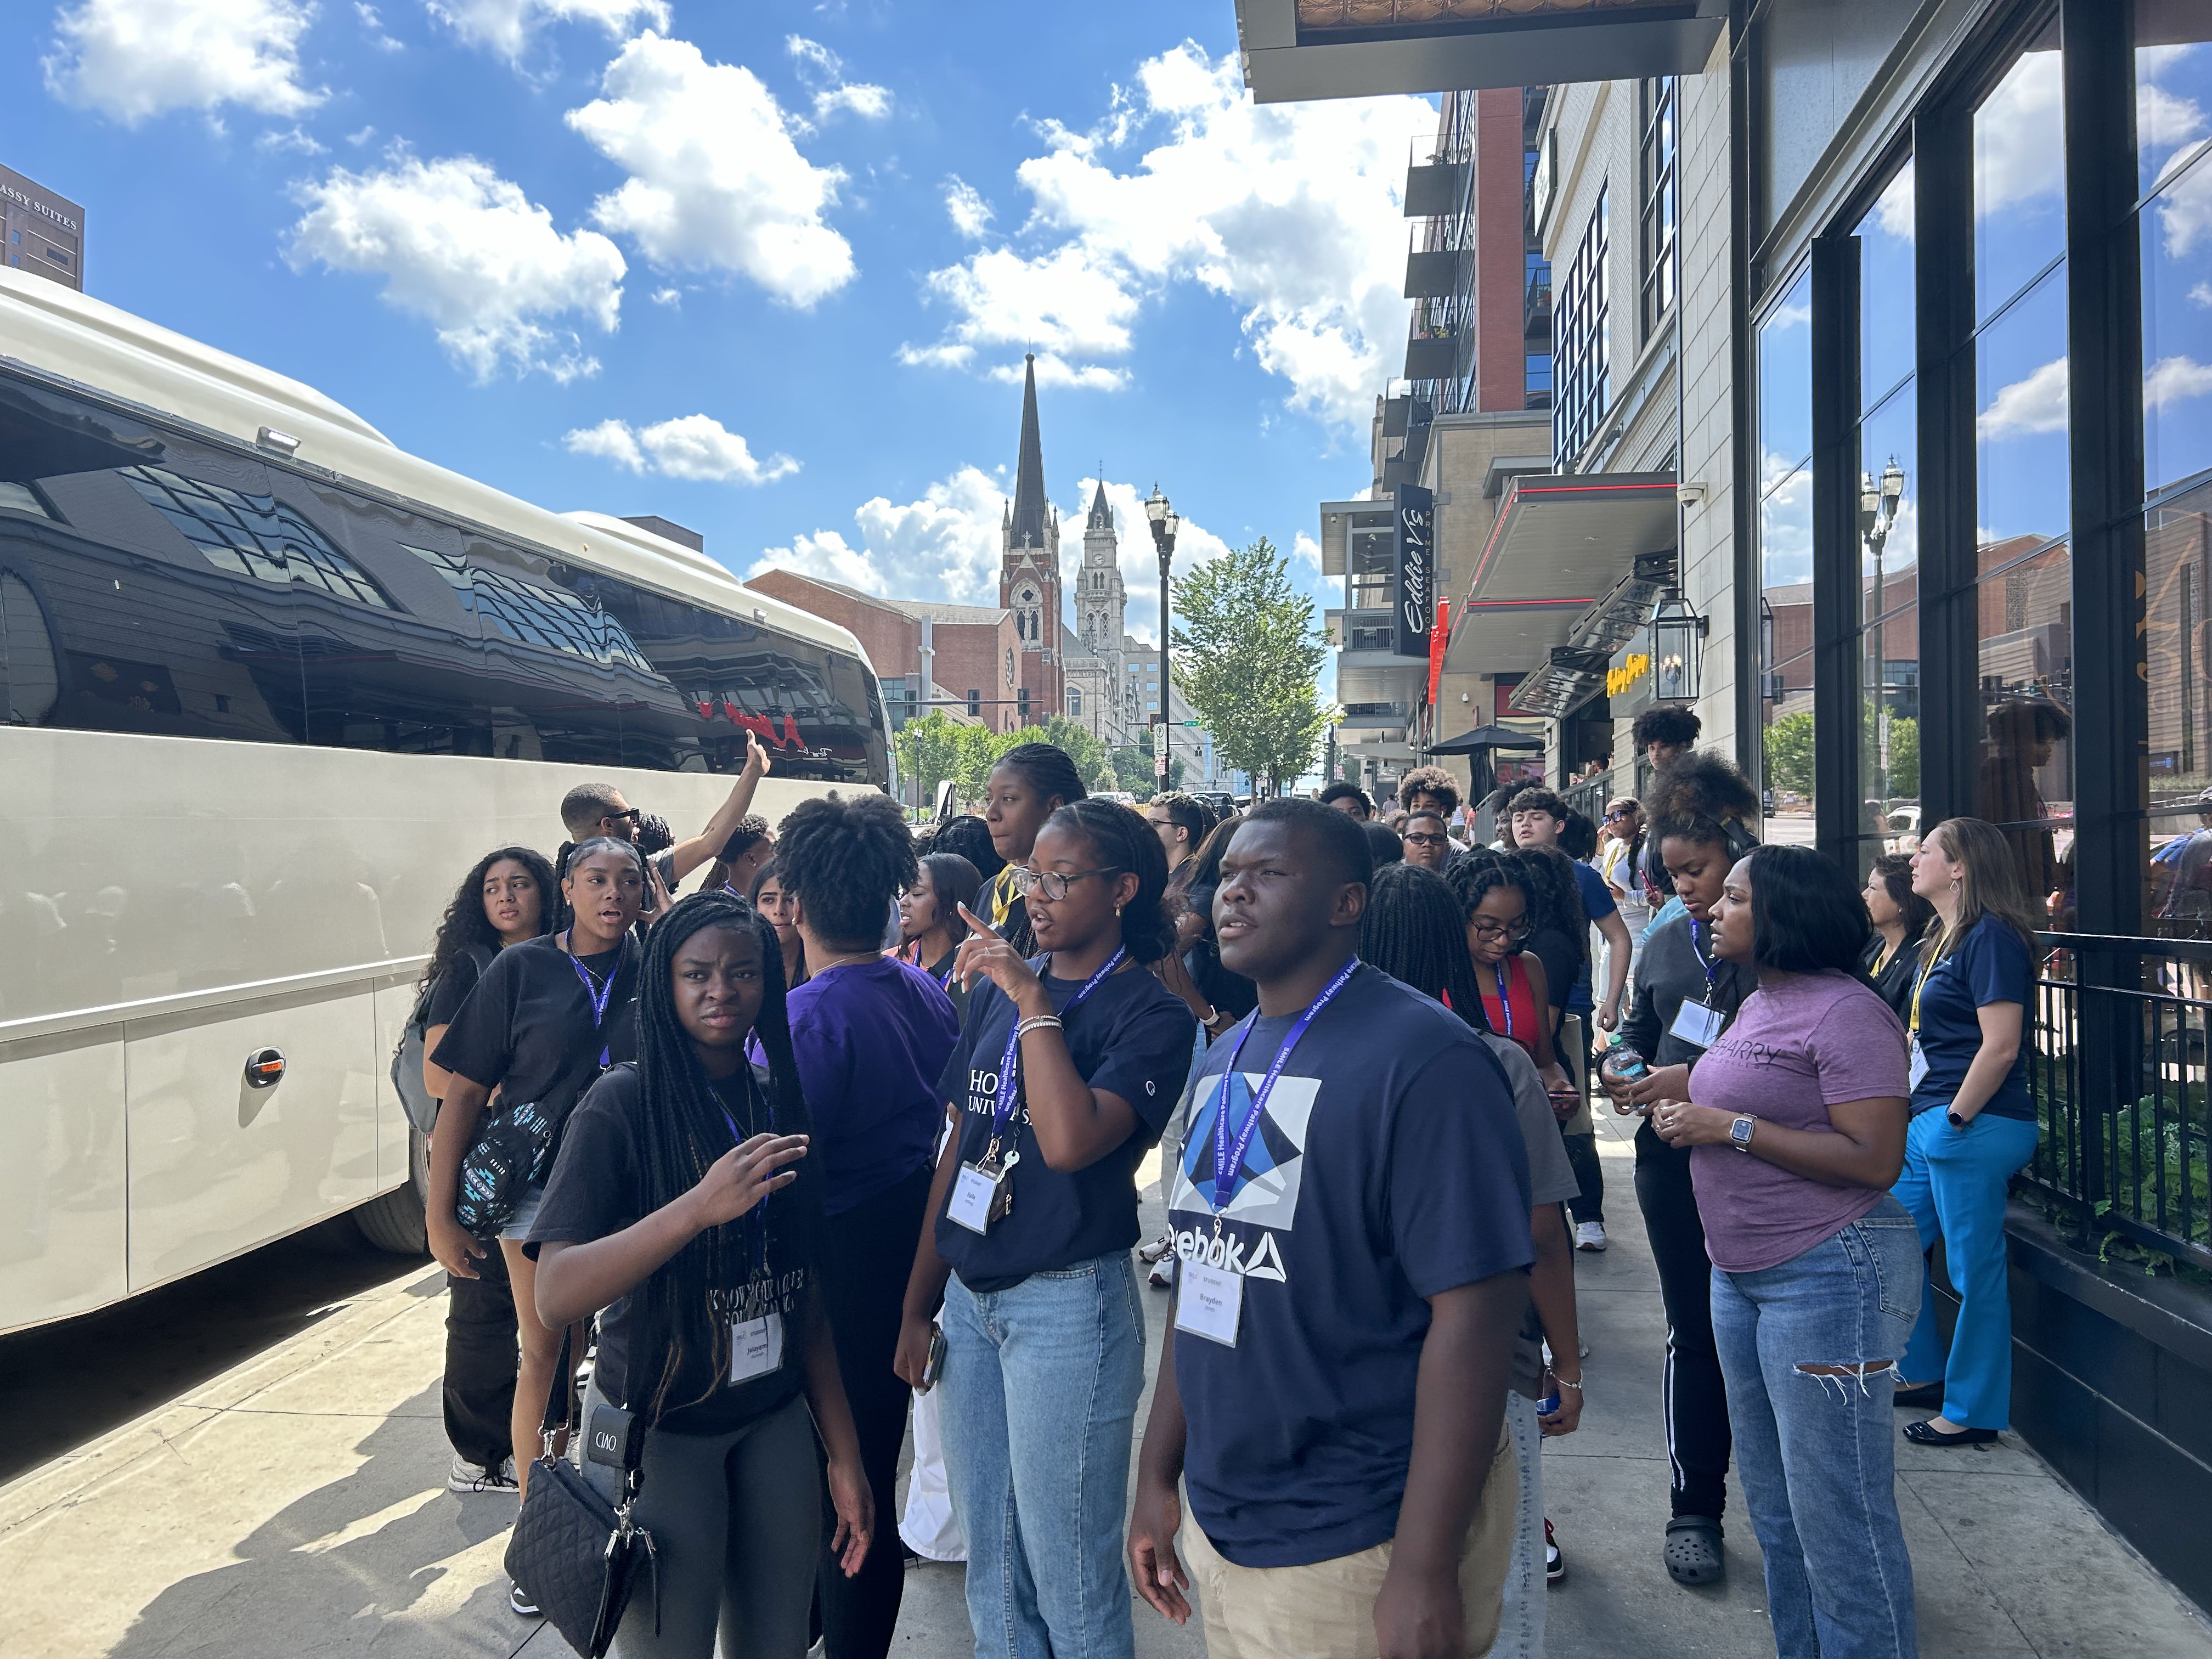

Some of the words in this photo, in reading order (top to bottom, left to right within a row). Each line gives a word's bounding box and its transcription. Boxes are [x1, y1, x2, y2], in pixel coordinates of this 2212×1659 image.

[0, 184, 31, 206] ASSY
[33, 201, 77, 230] SUITES
[1404, 550, 1424, 634] Eddie
[1096, 961, 1115, 980] Pathway
[1324, 972, 1350, 997] Pathway
[1077, 978, 1098, 999] Program
[1304, 995, 1329, 1022] Program
[1000, 1056, 1011, 1090] Healthcare
[1006, 1030, 1019, 1056] Pathway
[1277, 1047, 1289, 1069] SMILE
[1255, 1069, 1279, 1109] Healthcare
[1217, 1110, 1226, 1150] Healthcare
[1240, 1108, 1259, 1143] Pathway
[1227, 1141, 1246, 1177] Program
[1169, 1222, 1246, 1275] ebok
[1203, 1277, 1222, 1286] STUDENT
[1199, 1293, 1222, 1307] Brayden
